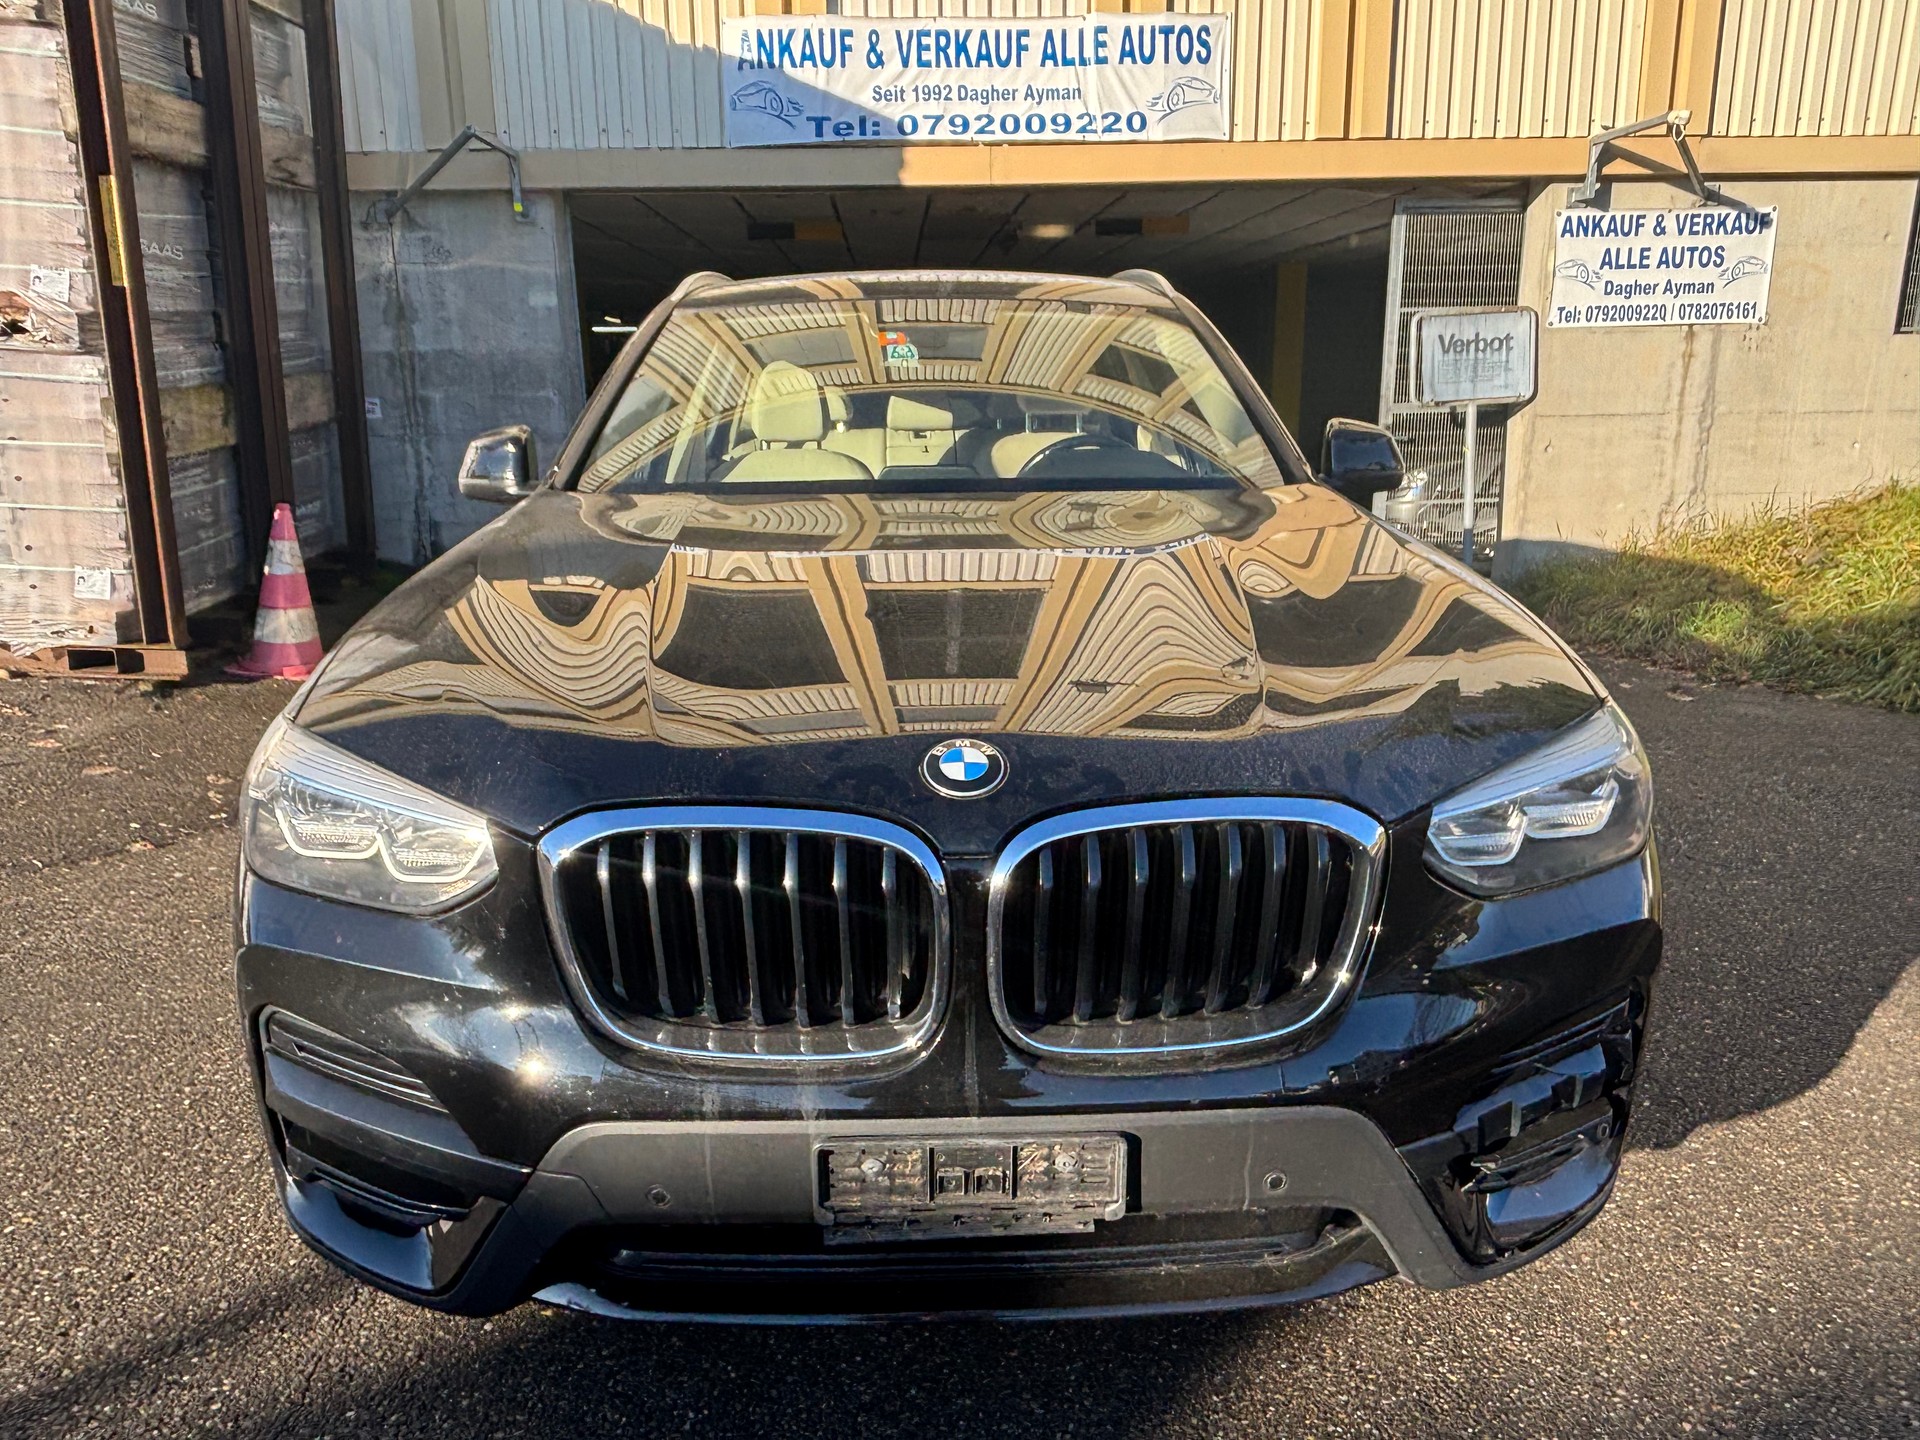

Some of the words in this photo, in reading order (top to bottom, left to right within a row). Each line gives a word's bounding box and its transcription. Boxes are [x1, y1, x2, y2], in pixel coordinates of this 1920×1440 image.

[738, 28, 854, 70] ANKAUF
[866, 27, 885, 69] &
[895, 28, 1031, 68] VERKAUF
[1040, 25, 1108, 67] ALLE
[1118, 24, 1213, 65] AUTOS
[872, 85, 905, 103] Seit
[911, 85, 953, 102] 1992
[957, 85, 1018, 105] Dagher
[1023, 84, 1082, 105] Ayman
[806, 114, 881, 138] Tel:
[897, 110, 1149, 137] 0792009220
[1560, 214, 1646, 237] ANKAUF
[1652, 213, 1667, 237] &
[1675, 211, 1771, 236] VERKAUF
[1599, 247, 1651, 270] ALLE
[1656, 245, 1726, 269] AUTOS
[1603, 280, 1659, 299] Dagher
[1663, 279, 1715, 299] Ayman
[1557, 306, 1581, 324] Tel:
[1678, 301, 1757, 321] 0782076161
[1438, 332, 1515, 355] Verbot
[931, 739, 996, 757] BMW
